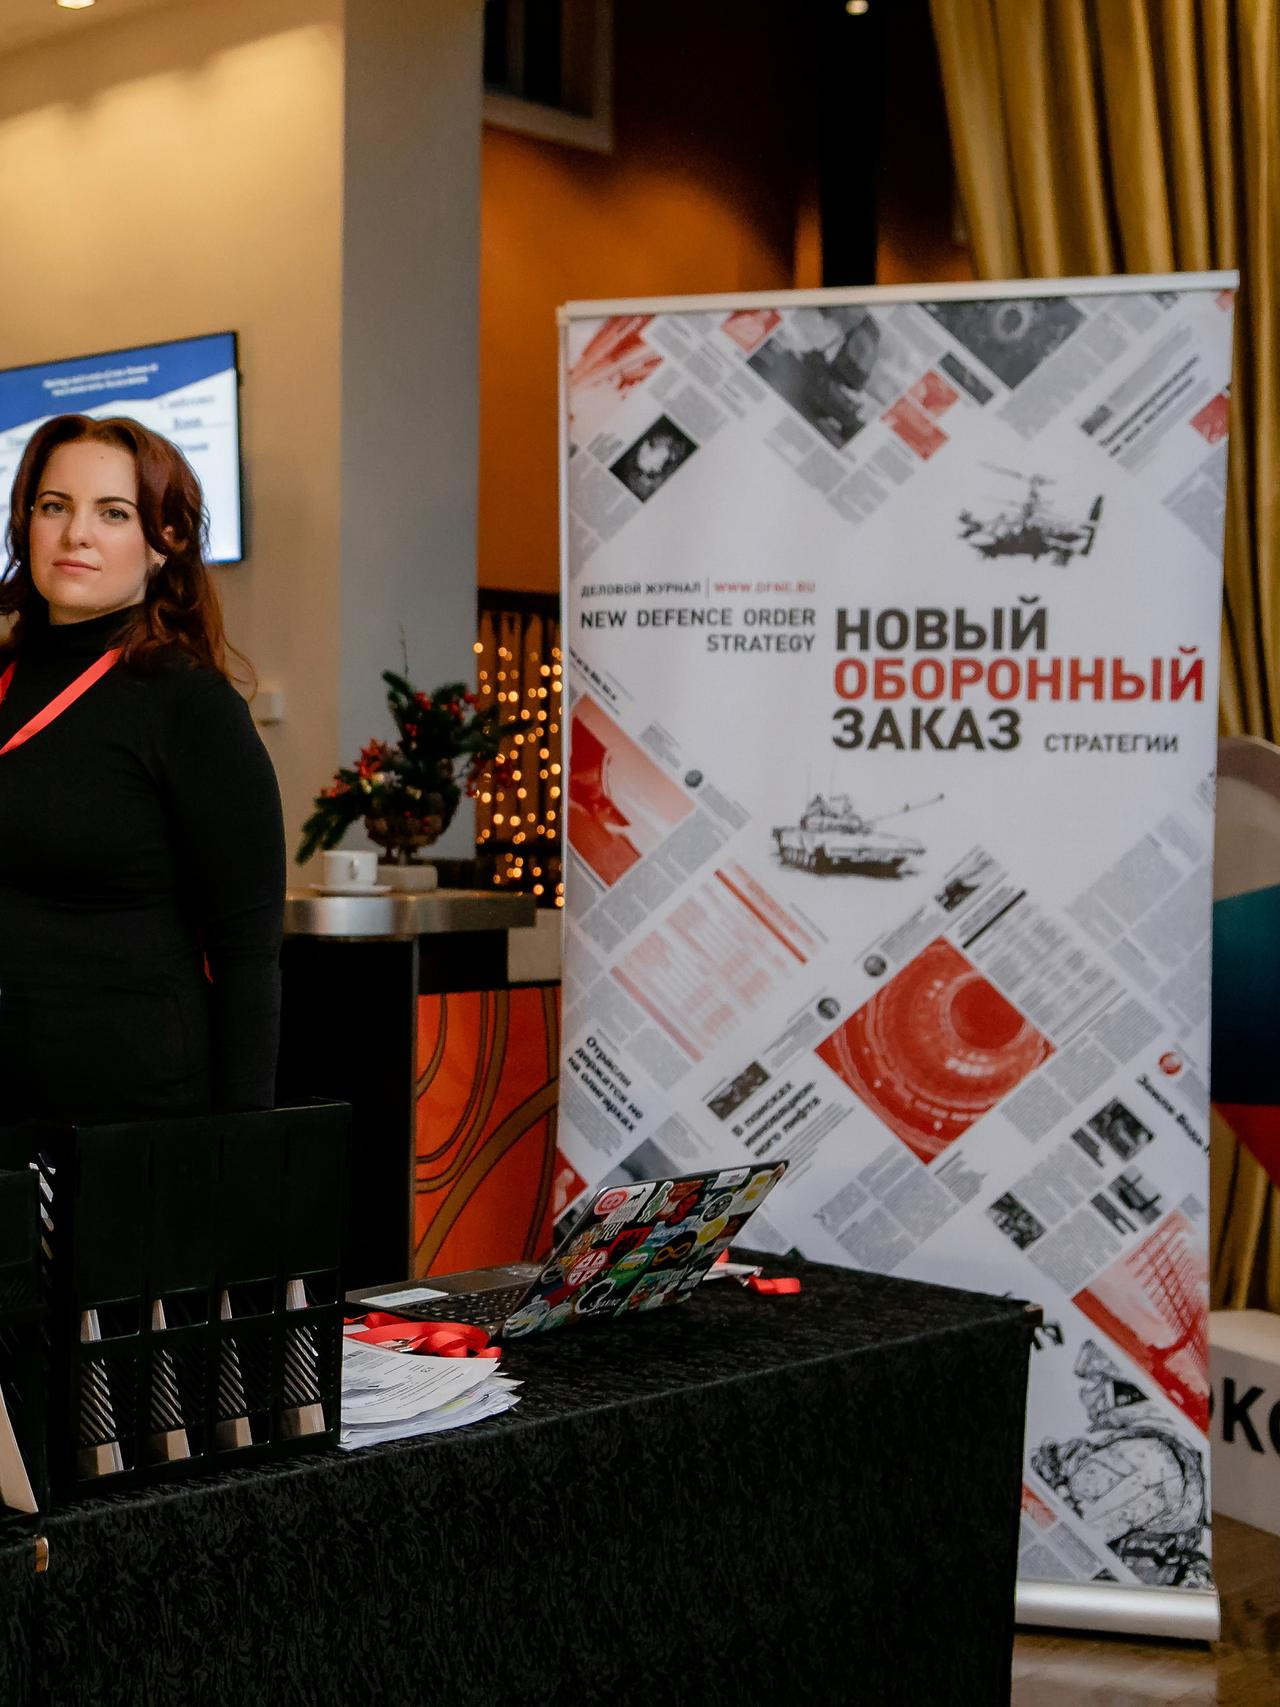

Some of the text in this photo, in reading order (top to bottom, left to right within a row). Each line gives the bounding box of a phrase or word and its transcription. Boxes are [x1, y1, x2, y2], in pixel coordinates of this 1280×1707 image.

[581, 582, 701, 598] ДЕЛОВОЙ ЖУРНАЛ
[581, 608, 816, 629] NEW DEFENCE ORDER
[835, 596, 1047, 651] НОВЫЙ
[707, 633, 816, 653] STRATEGY
[834, 646, 1205, 702] ОБОРОННЫЙ
[832, 707, 1021, 751] ЗАКАЗ
[1044, 734, 1179, 753] СТРАТЕГИИ
